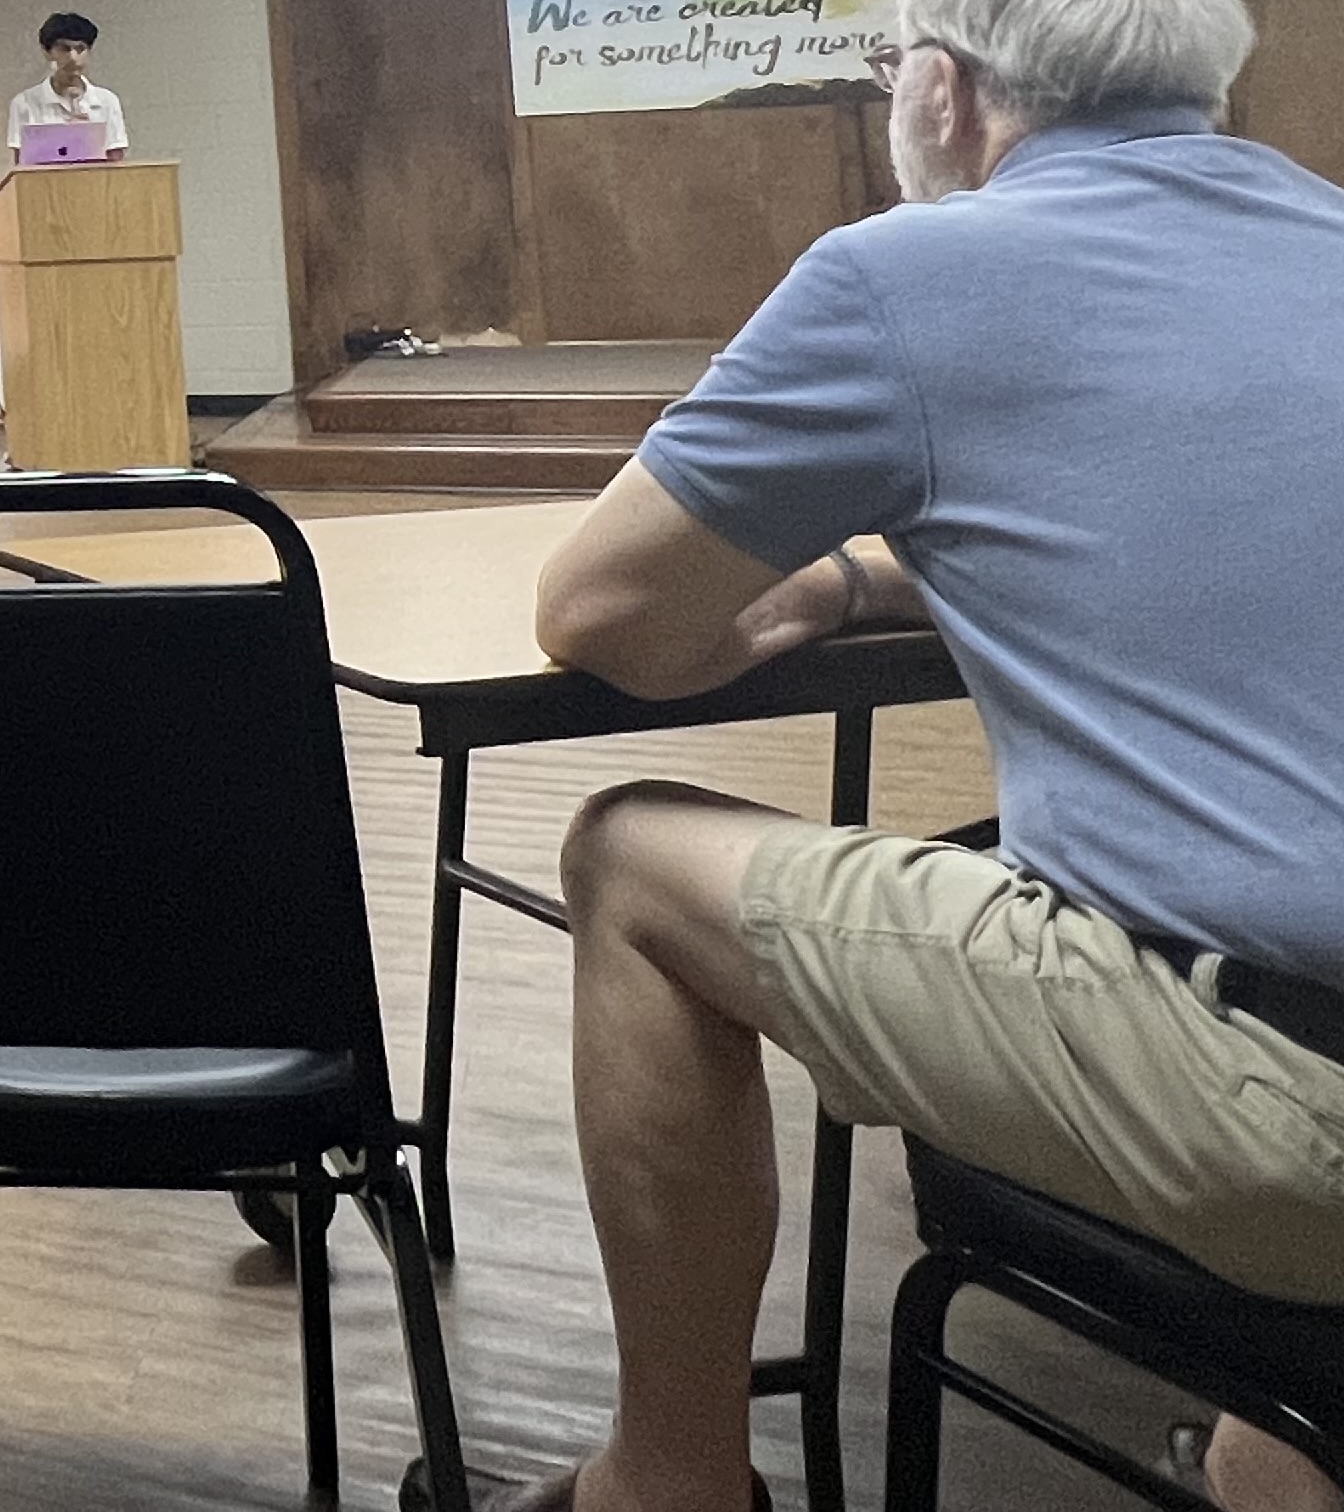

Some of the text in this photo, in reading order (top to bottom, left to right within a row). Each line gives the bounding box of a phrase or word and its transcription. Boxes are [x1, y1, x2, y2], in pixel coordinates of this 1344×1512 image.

[602, 4, 664, 26] are
[534, 44, 587, 85] for
[598, 22, 782, 76] something
